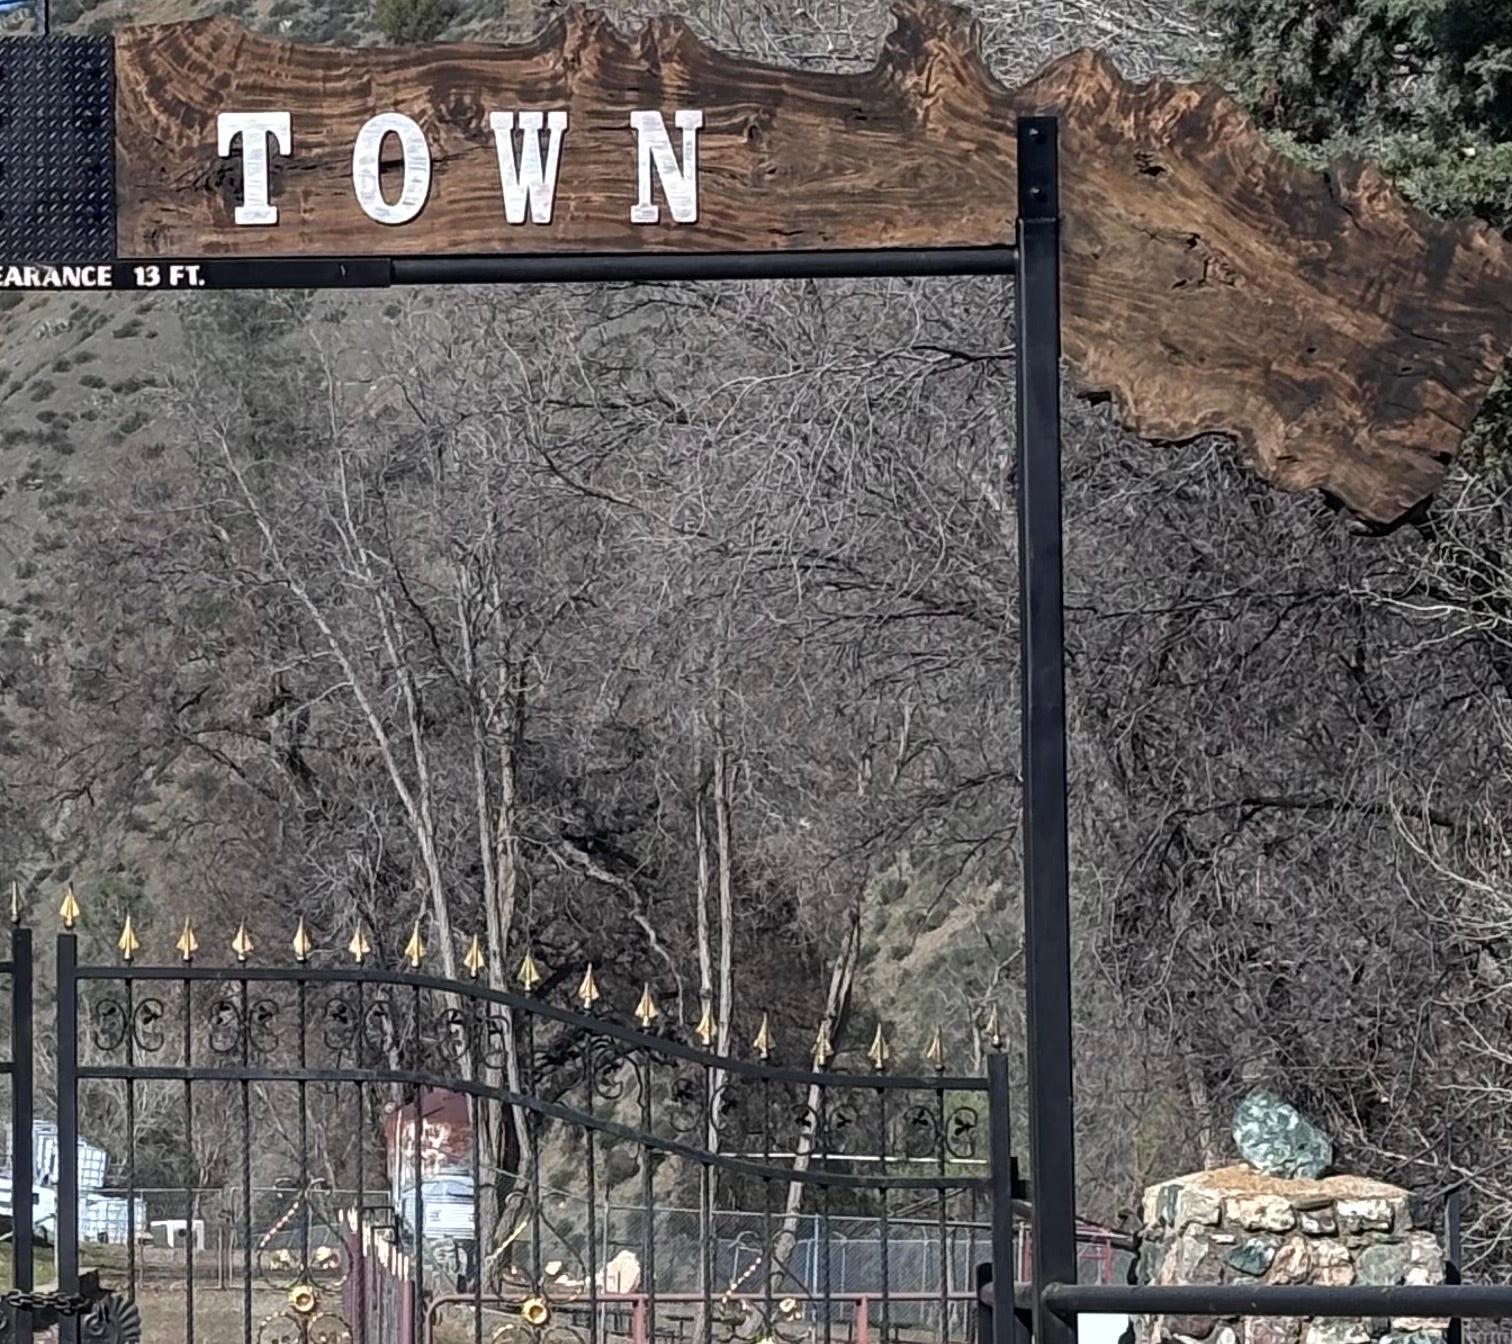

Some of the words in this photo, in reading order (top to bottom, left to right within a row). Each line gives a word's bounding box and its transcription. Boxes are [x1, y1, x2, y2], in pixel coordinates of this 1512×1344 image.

[216, 110, 704, 227] TOWN
[133, 265, 161, 287] 13
[169, 265, 206, 287] FT.
